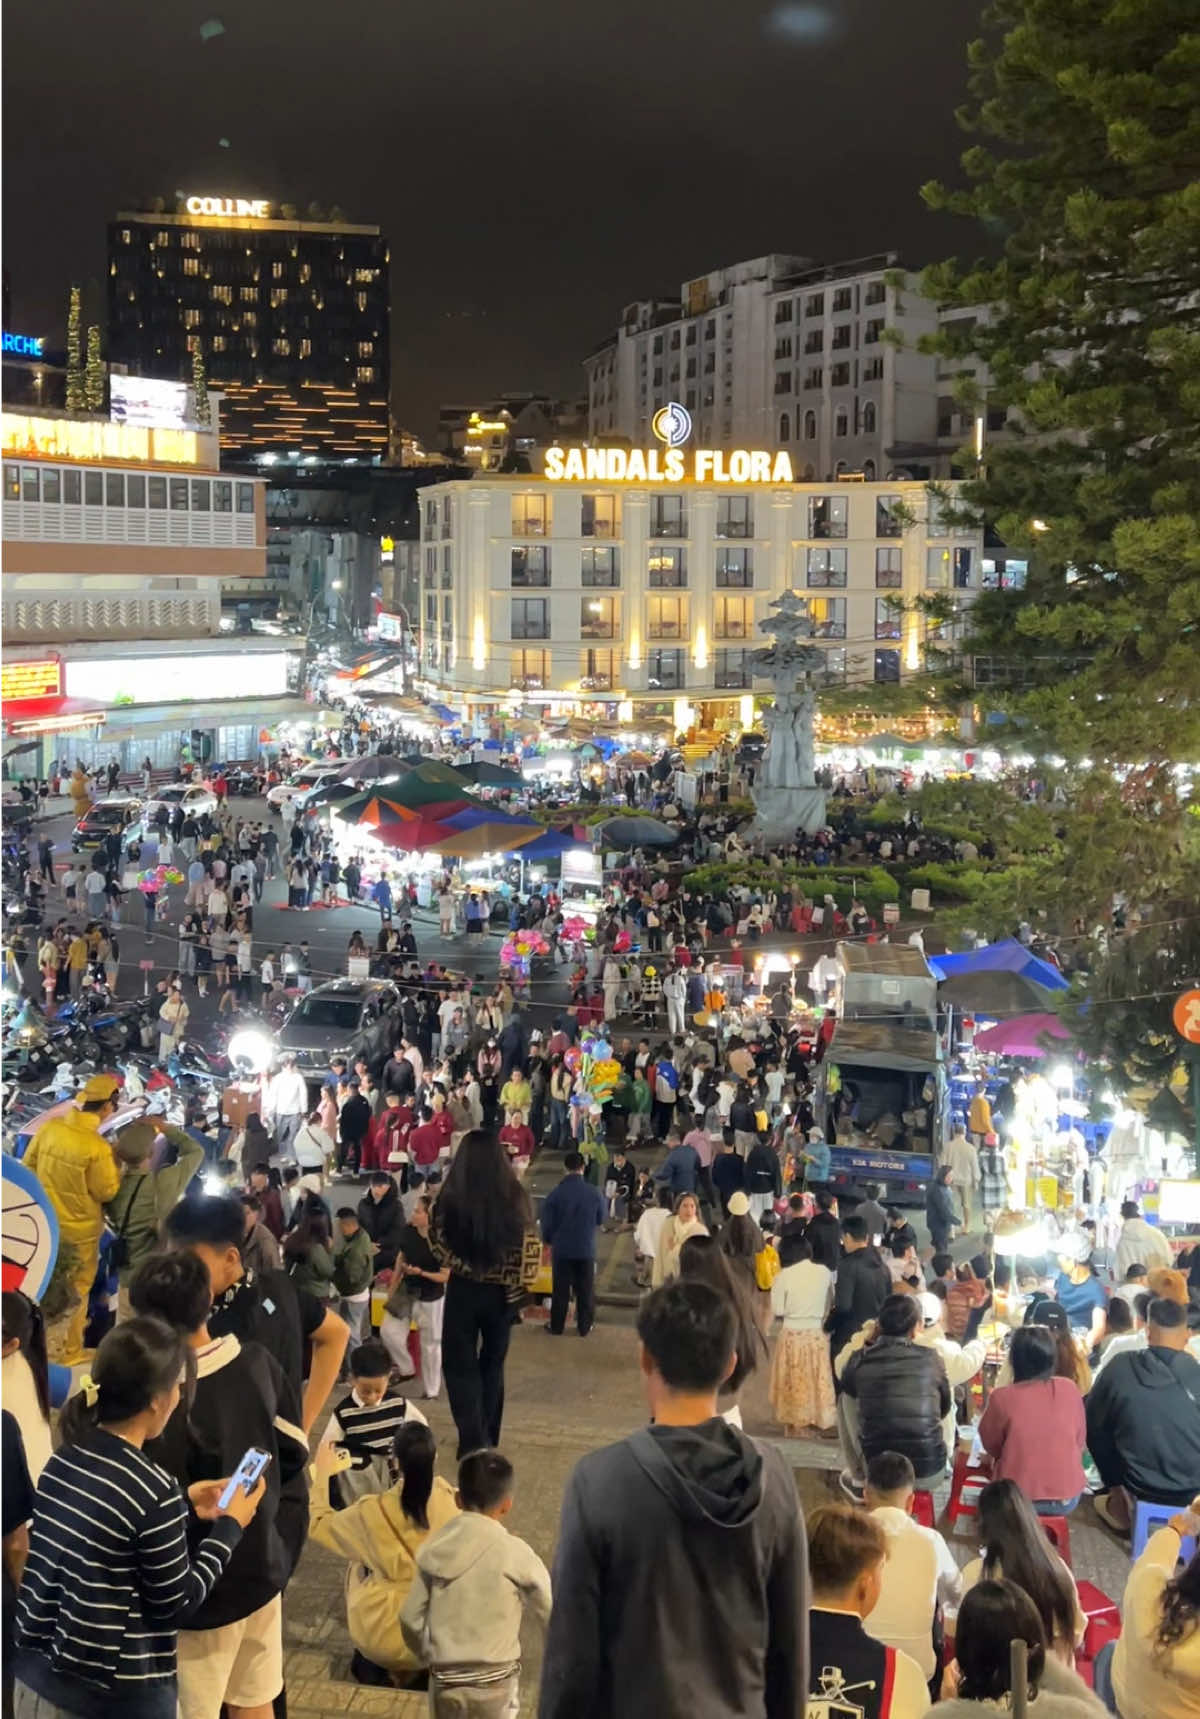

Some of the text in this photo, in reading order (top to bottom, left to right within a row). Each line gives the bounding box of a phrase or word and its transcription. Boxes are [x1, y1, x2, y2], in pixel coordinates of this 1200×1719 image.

[187, 197, 270, 217] COLLINE
[2, 333, 43, 356] RCHE
[544, 448, 793, 481] SANDALS FLORA
